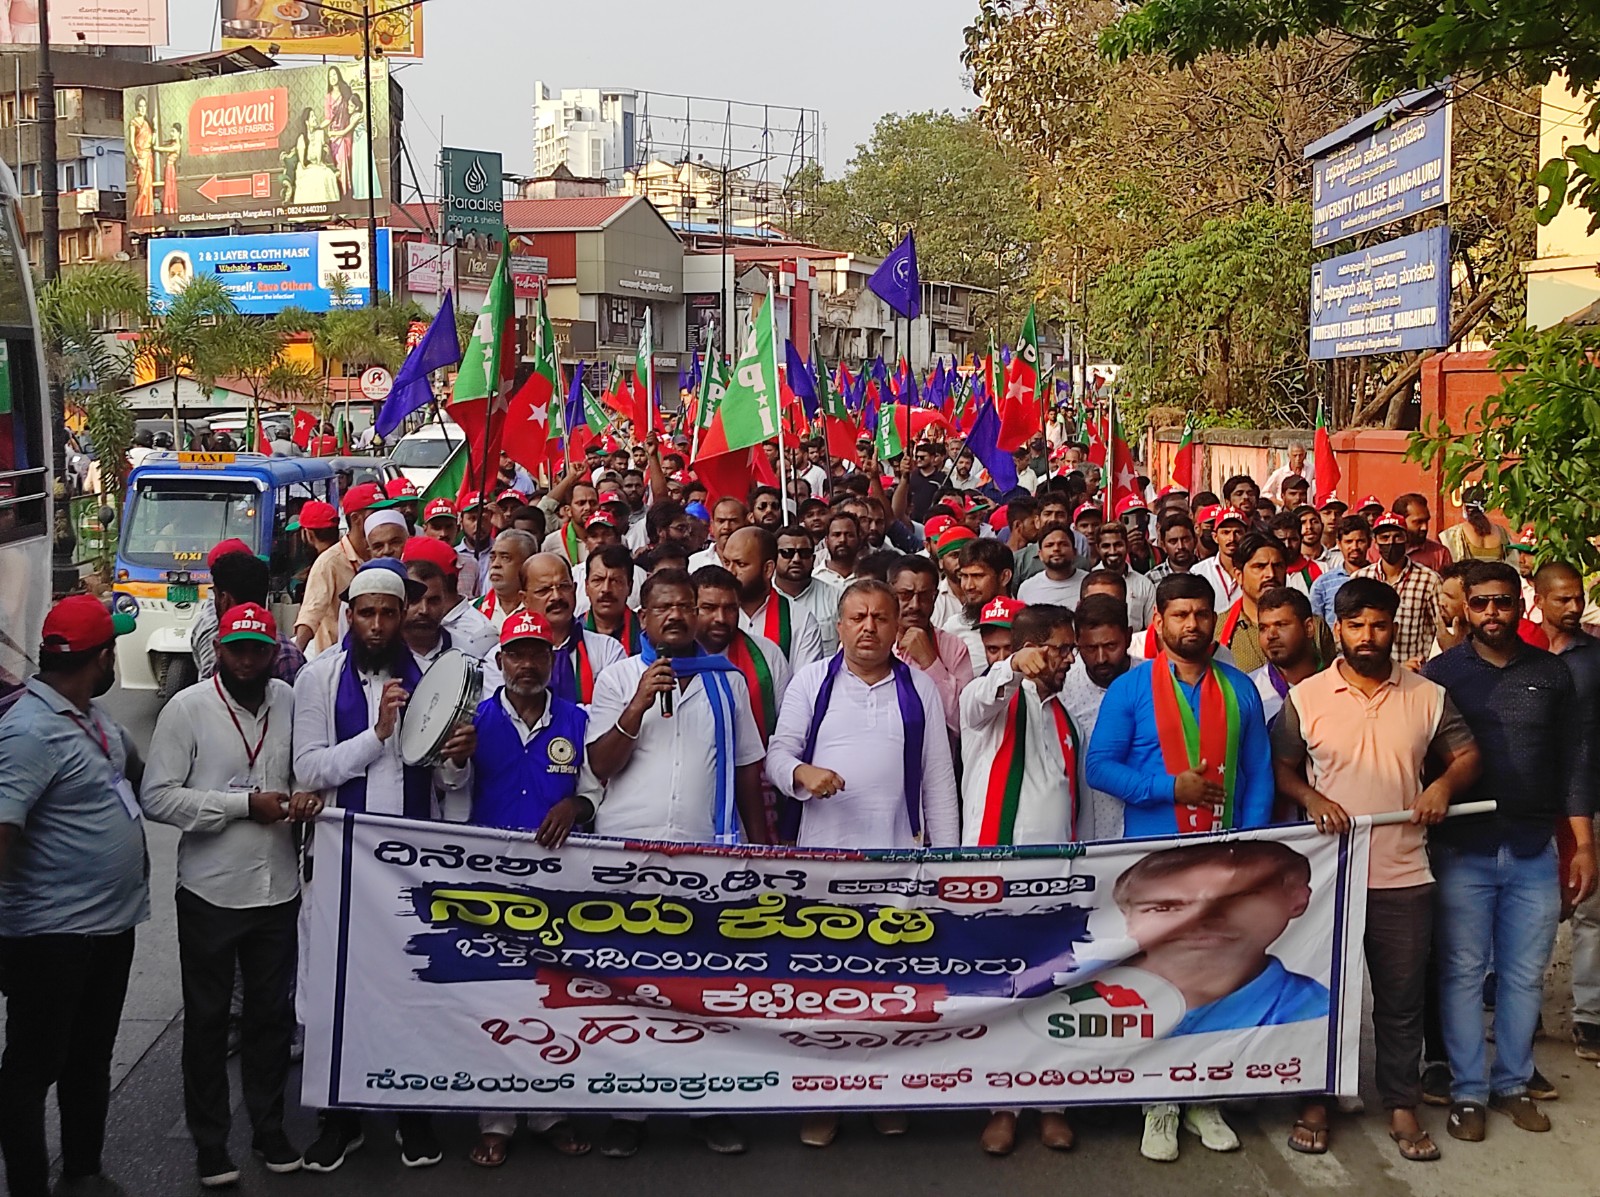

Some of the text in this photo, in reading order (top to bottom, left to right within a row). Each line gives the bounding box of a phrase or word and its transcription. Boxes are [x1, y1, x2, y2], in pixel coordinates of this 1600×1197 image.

[201, 95, 274, 137] paavani
[218, 126, 238, 137] SILKS
[244, 122, 274, 134] FABRICS
[1314, 158, 1441, 226] UNIVERSITY COLLEGE MANGALURU
[448, 194, 502, 212] Paradise
[448, 213, 472, 224] abaya
[473, 215, 479, 223] &
[198, 247, 310, 261] 2 & 3 LAYER CLOTH MASK
[218, 262, 251, 273] Washable
[257, 262, 288, 272] Reusable
[353, 271, 369, 280] TAG
[257, 281, 278, 292] Save
[1313, 306, 1437, 341] UNIVERSITY EVENING COLLEGE, MANGALURU
[190, 453, 224, 463] TAXI
[431, 506, 452, 514] SDPI
[173, 552, 202, 560] TAXI
[985, 608, 1010, 619] SDPI
[232, 619, 267, 632] SDPI
[513, 623, 542, 634] SDPI
[374, 840, 808, 902] ದಿನೇಶ್ ಕನ್ಯಾಡಿಗೆ
[944, 880, 999, 899] 29
[1009, 876, 1087, 896] 2022
[431, 889, 936, 946] ನ್ಯಾಯ ಕೊಡಿ
[455, 933, 1027, 976] ಬೆಳ್ತಂಗಡಿಯಿಂದ ಮಂಗಳೂರು
[702, 982, 918, 1018] ಕಛೇರಿಗೆ
[1047, 1012, 1155, 1039] SDPI
[366, 1067, 576, 1094] ಸೋಶಿಯಲ್
[586, 1070, 780, 1100] ಡೆಮಾಕ್ರಟಿಕ್
[791, 1072, 888, 1092] ಪಾರ್ಟಿ
[901, 1066, 974, 1093] ಆಫ್
[984, 1064, 1134, 1088] ಇಂಡಿಯಾ
[1168, 1061, 1235, 1082] ದ.ಕ
[1246, 1055, 1303, 1085] ಜಿಲ್ಲೆ
